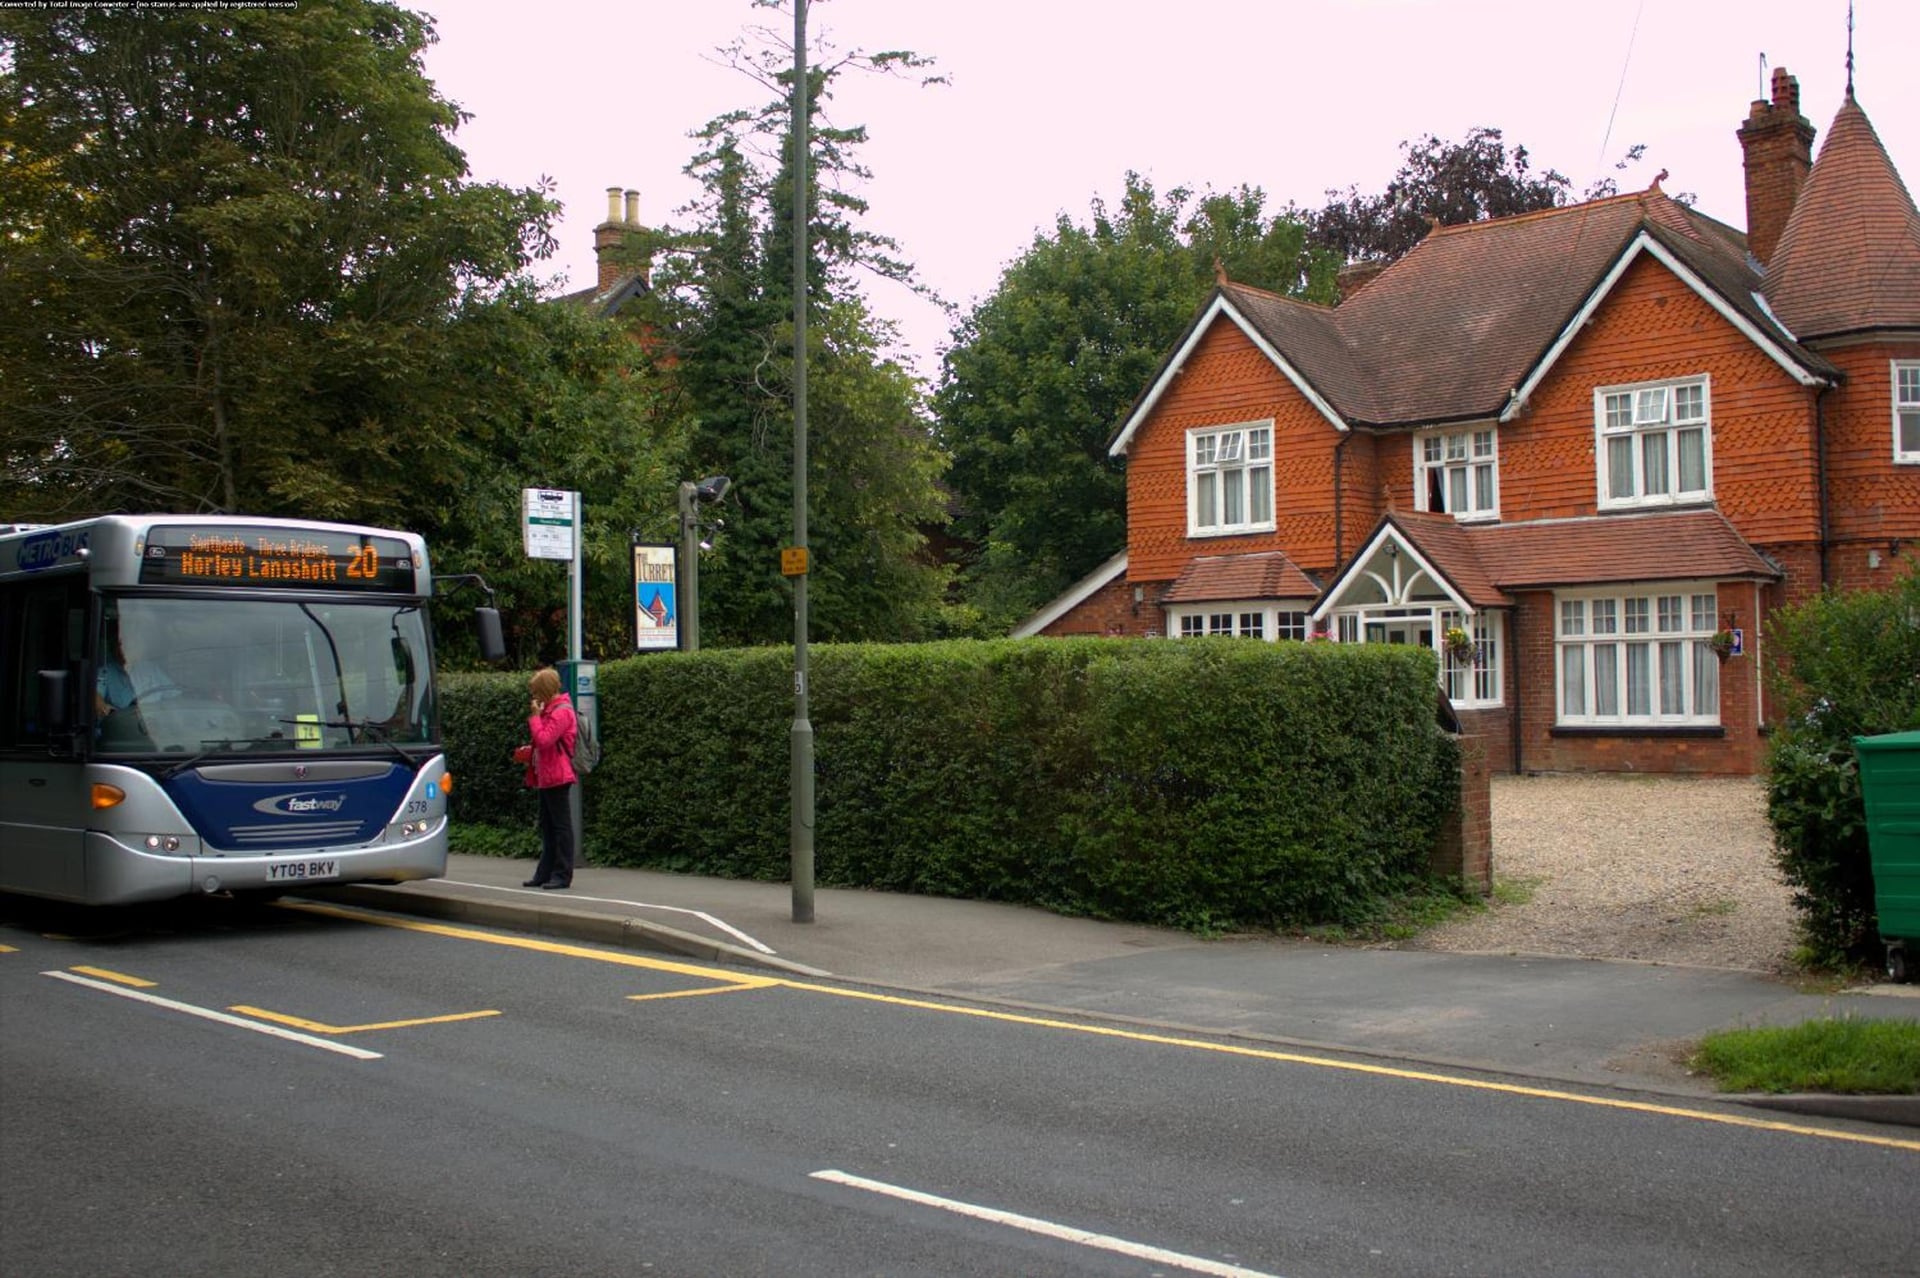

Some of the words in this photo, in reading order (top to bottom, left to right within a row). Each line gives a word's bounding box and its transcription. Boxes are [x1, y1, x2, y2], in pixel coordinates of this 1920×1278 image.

[258, 538, 286, 556] Three
[181, 552, 243, 578] Horley
[346, 544, 379, 579] 20
[636, 553, 674, 582] TURRET
[287, 797, 343, 813] fastway
[408, 801, 428, 814] 578
[270, 863, 307, 877] YT09
[308, 861, 335, 876] BKV
